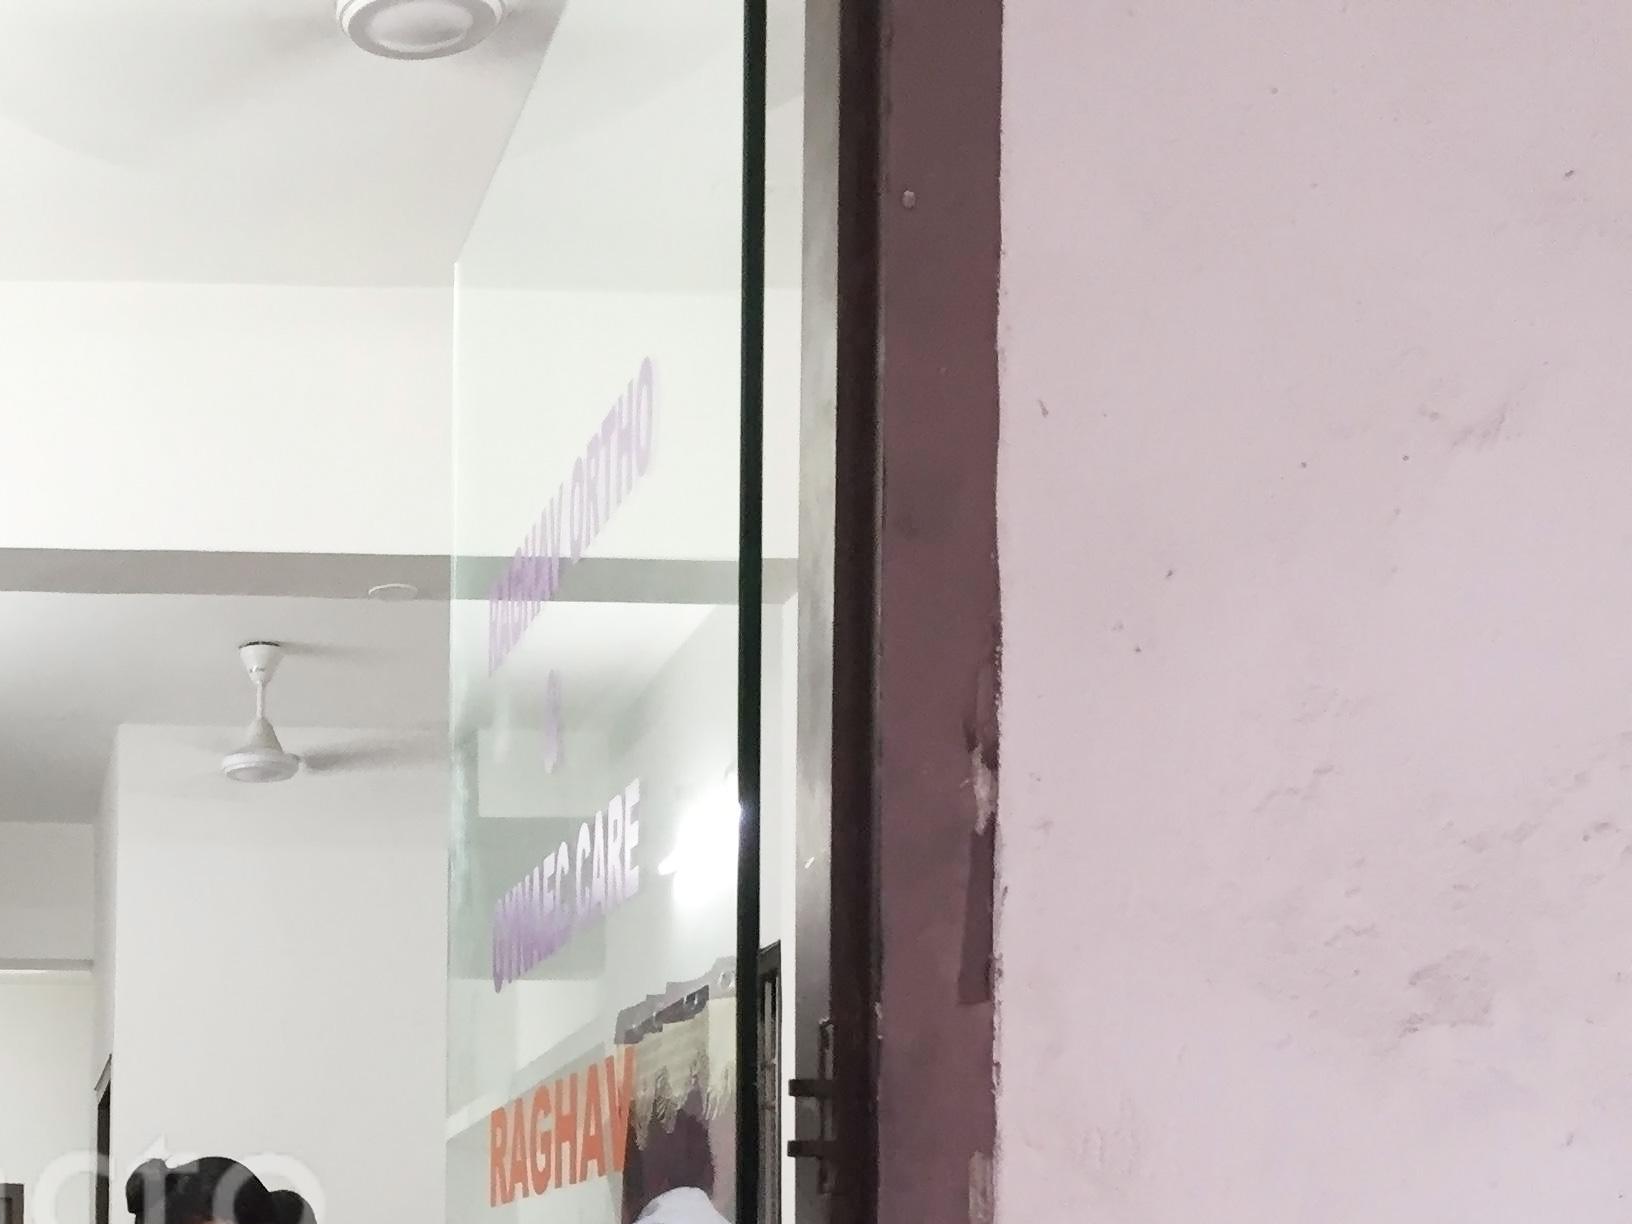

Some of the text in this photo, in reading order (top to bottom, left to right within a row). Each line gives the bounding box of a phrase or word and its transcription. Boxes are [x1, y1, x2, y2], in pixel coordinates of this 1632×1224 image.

[570, 356, 654, 565] ORTHO
[576, 778, 640, 926] CARE
[490, 1046, 636, 1207] RAGHAV
